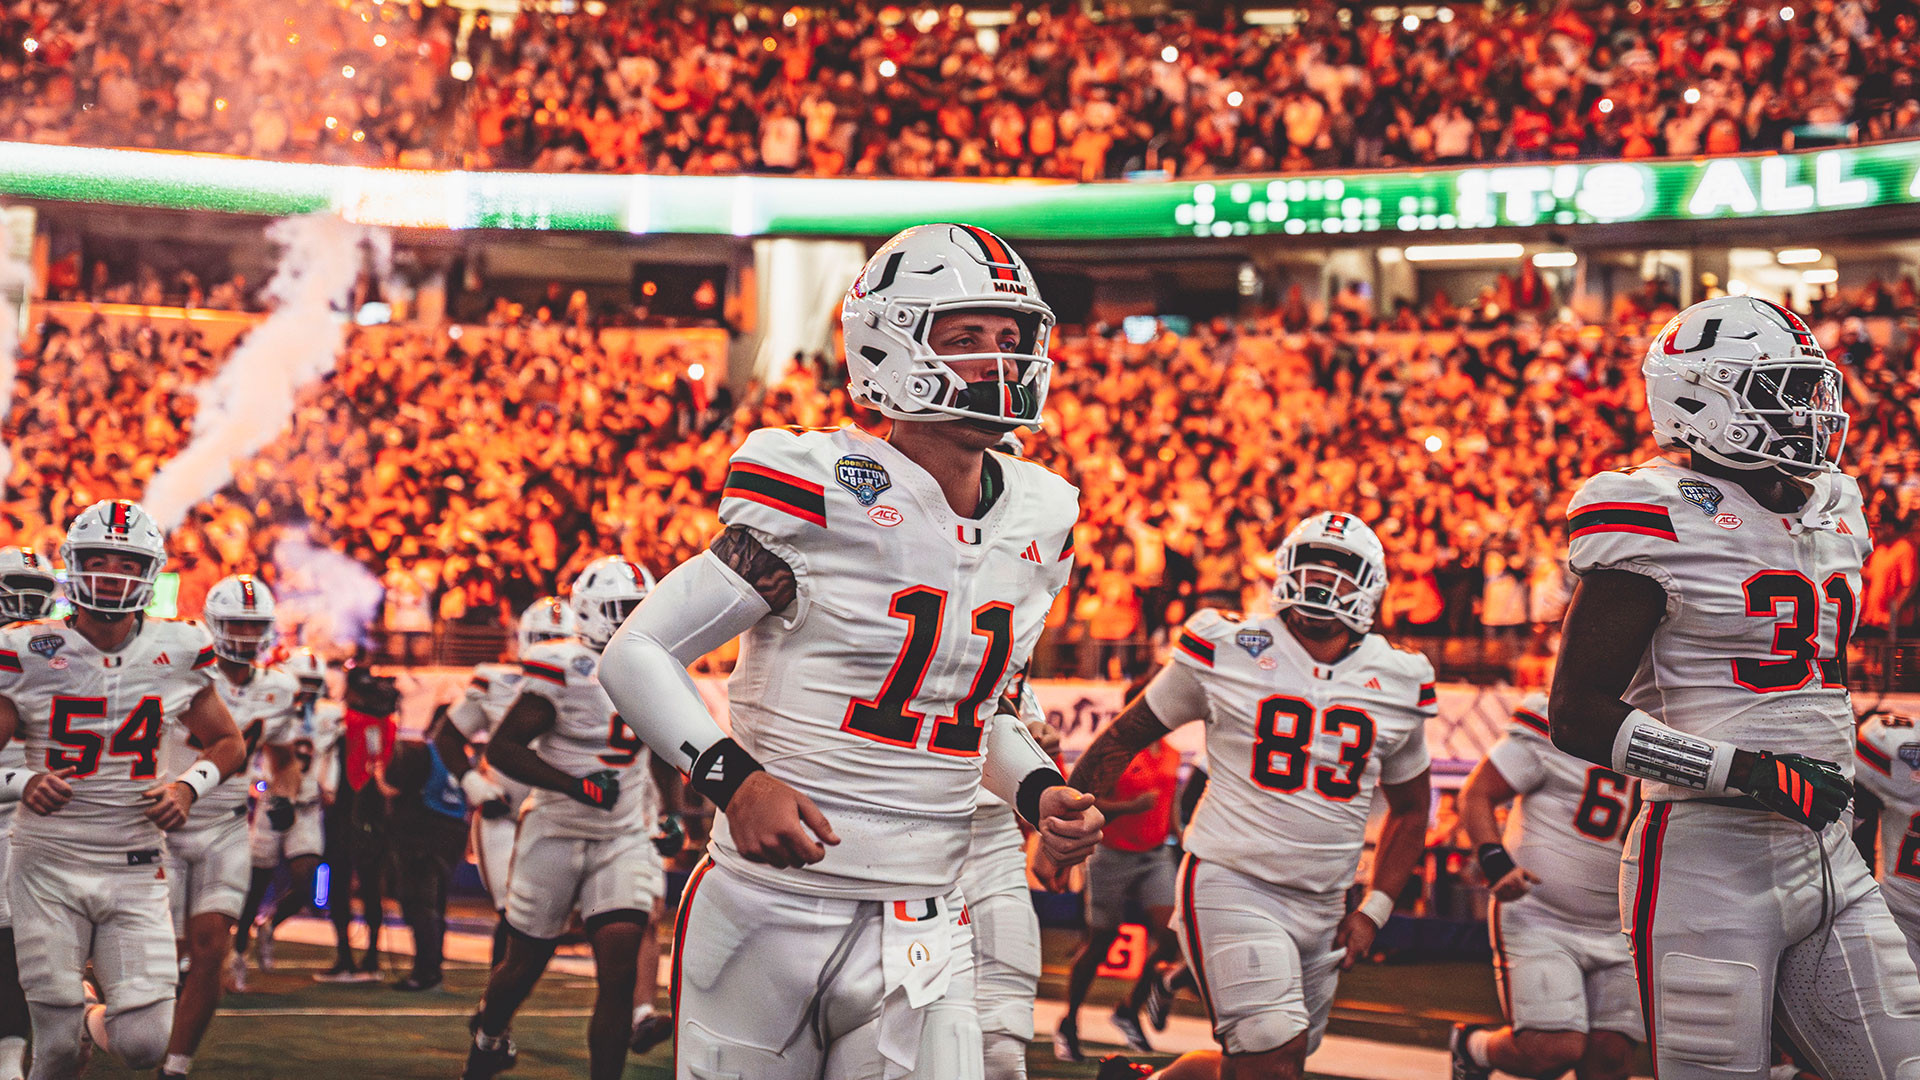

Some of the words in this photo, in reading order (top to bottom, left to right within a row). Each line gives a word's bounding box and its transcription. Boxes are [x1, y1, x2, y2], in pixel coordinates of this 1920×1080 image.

[1457, 163, 1645, 223] IT'S
[1689, 152, 1868, 214] ALL
[993, 281, 1028, 296] MIAMI
[1663, 317, 1723, 355] U
[839, 466, 888, 486] COTTON
[849, 476, 881, 488] BOWL
[872, 510, 899, 521] ACC
[956, 525, 982, 545] U
[1731, 569, 1857, 694] 31
[840, 584, 1015, 757] 11
[46, 695, 163, 779] 54
[1251, 694, 1377, 802] 83
[893, 897, 938, 922] U
